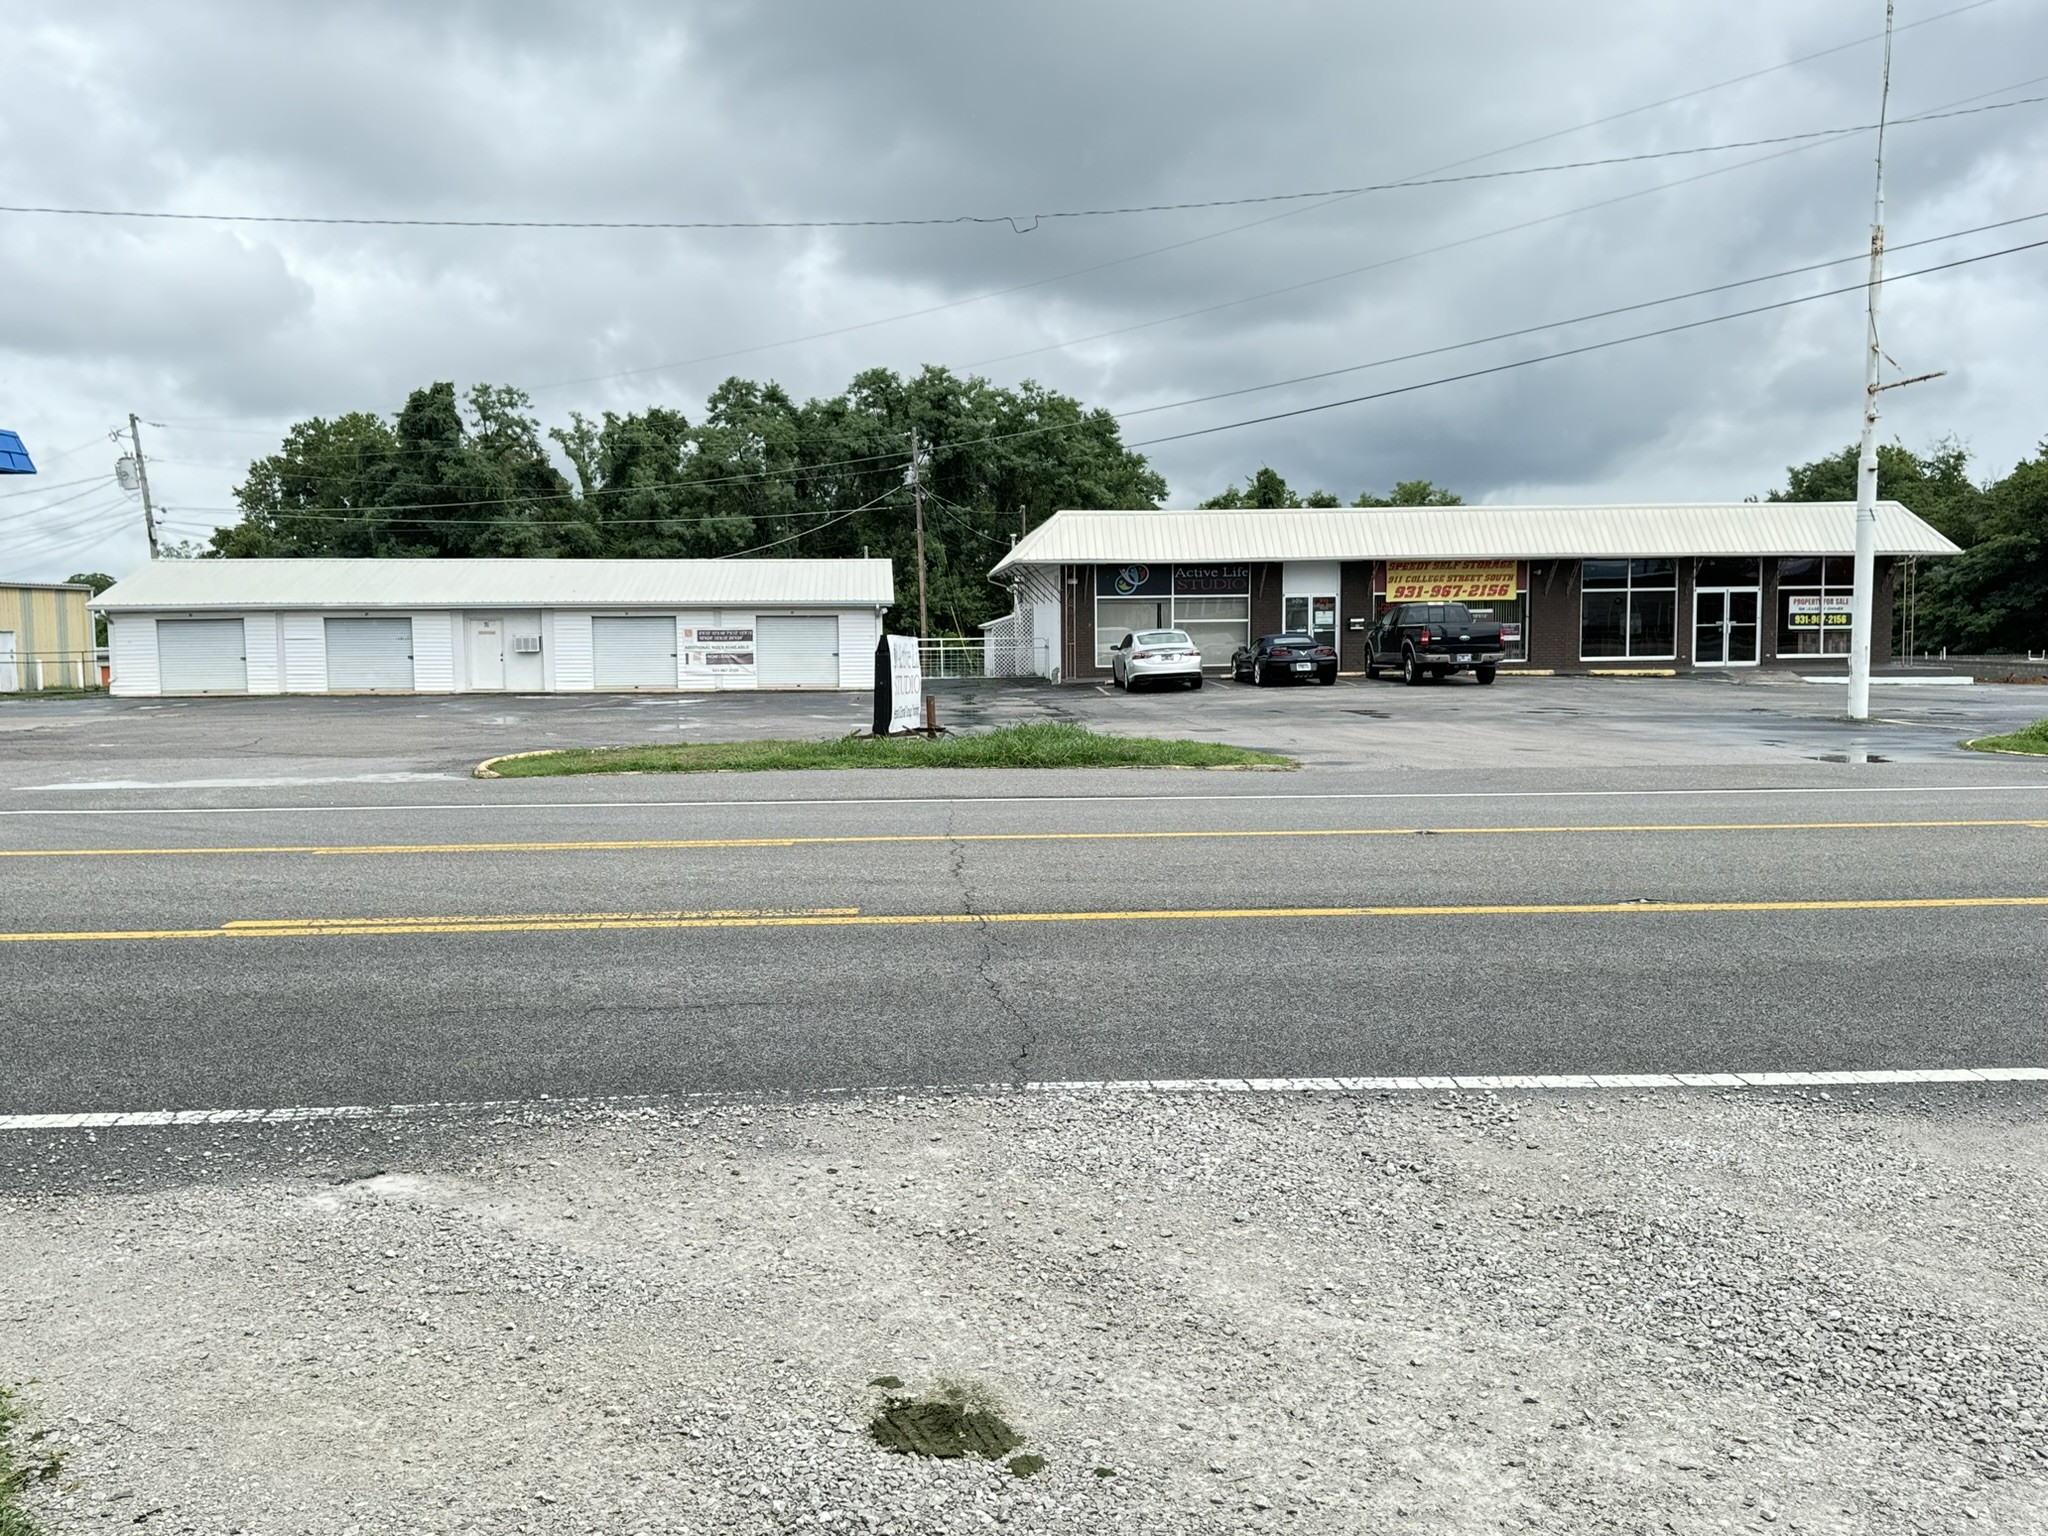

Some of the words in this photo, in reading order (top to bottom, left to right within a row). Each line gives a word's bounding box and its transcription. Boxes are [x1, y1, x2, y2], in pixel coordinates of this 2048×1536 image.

[1388, 561, 1432, 571] SPEEDY
[1432, 561, 1459, 570] SELF
[1462, 560, 1514, 570] STORAGE
[1175, 567, 1219, 578] Active
[1223, 566, 1249, 577] Life
[1177, 579, 1247, 590] STUDIO
[1388, 576, 1404, 584] 911
[1405, 575, 1446, 583] COLLEGE
[1447, 574, 1484, 582] STREET
[1484, 574, 1514, 582] SOUTH
[1393, 584, 1510, 599] 931-967-2156
